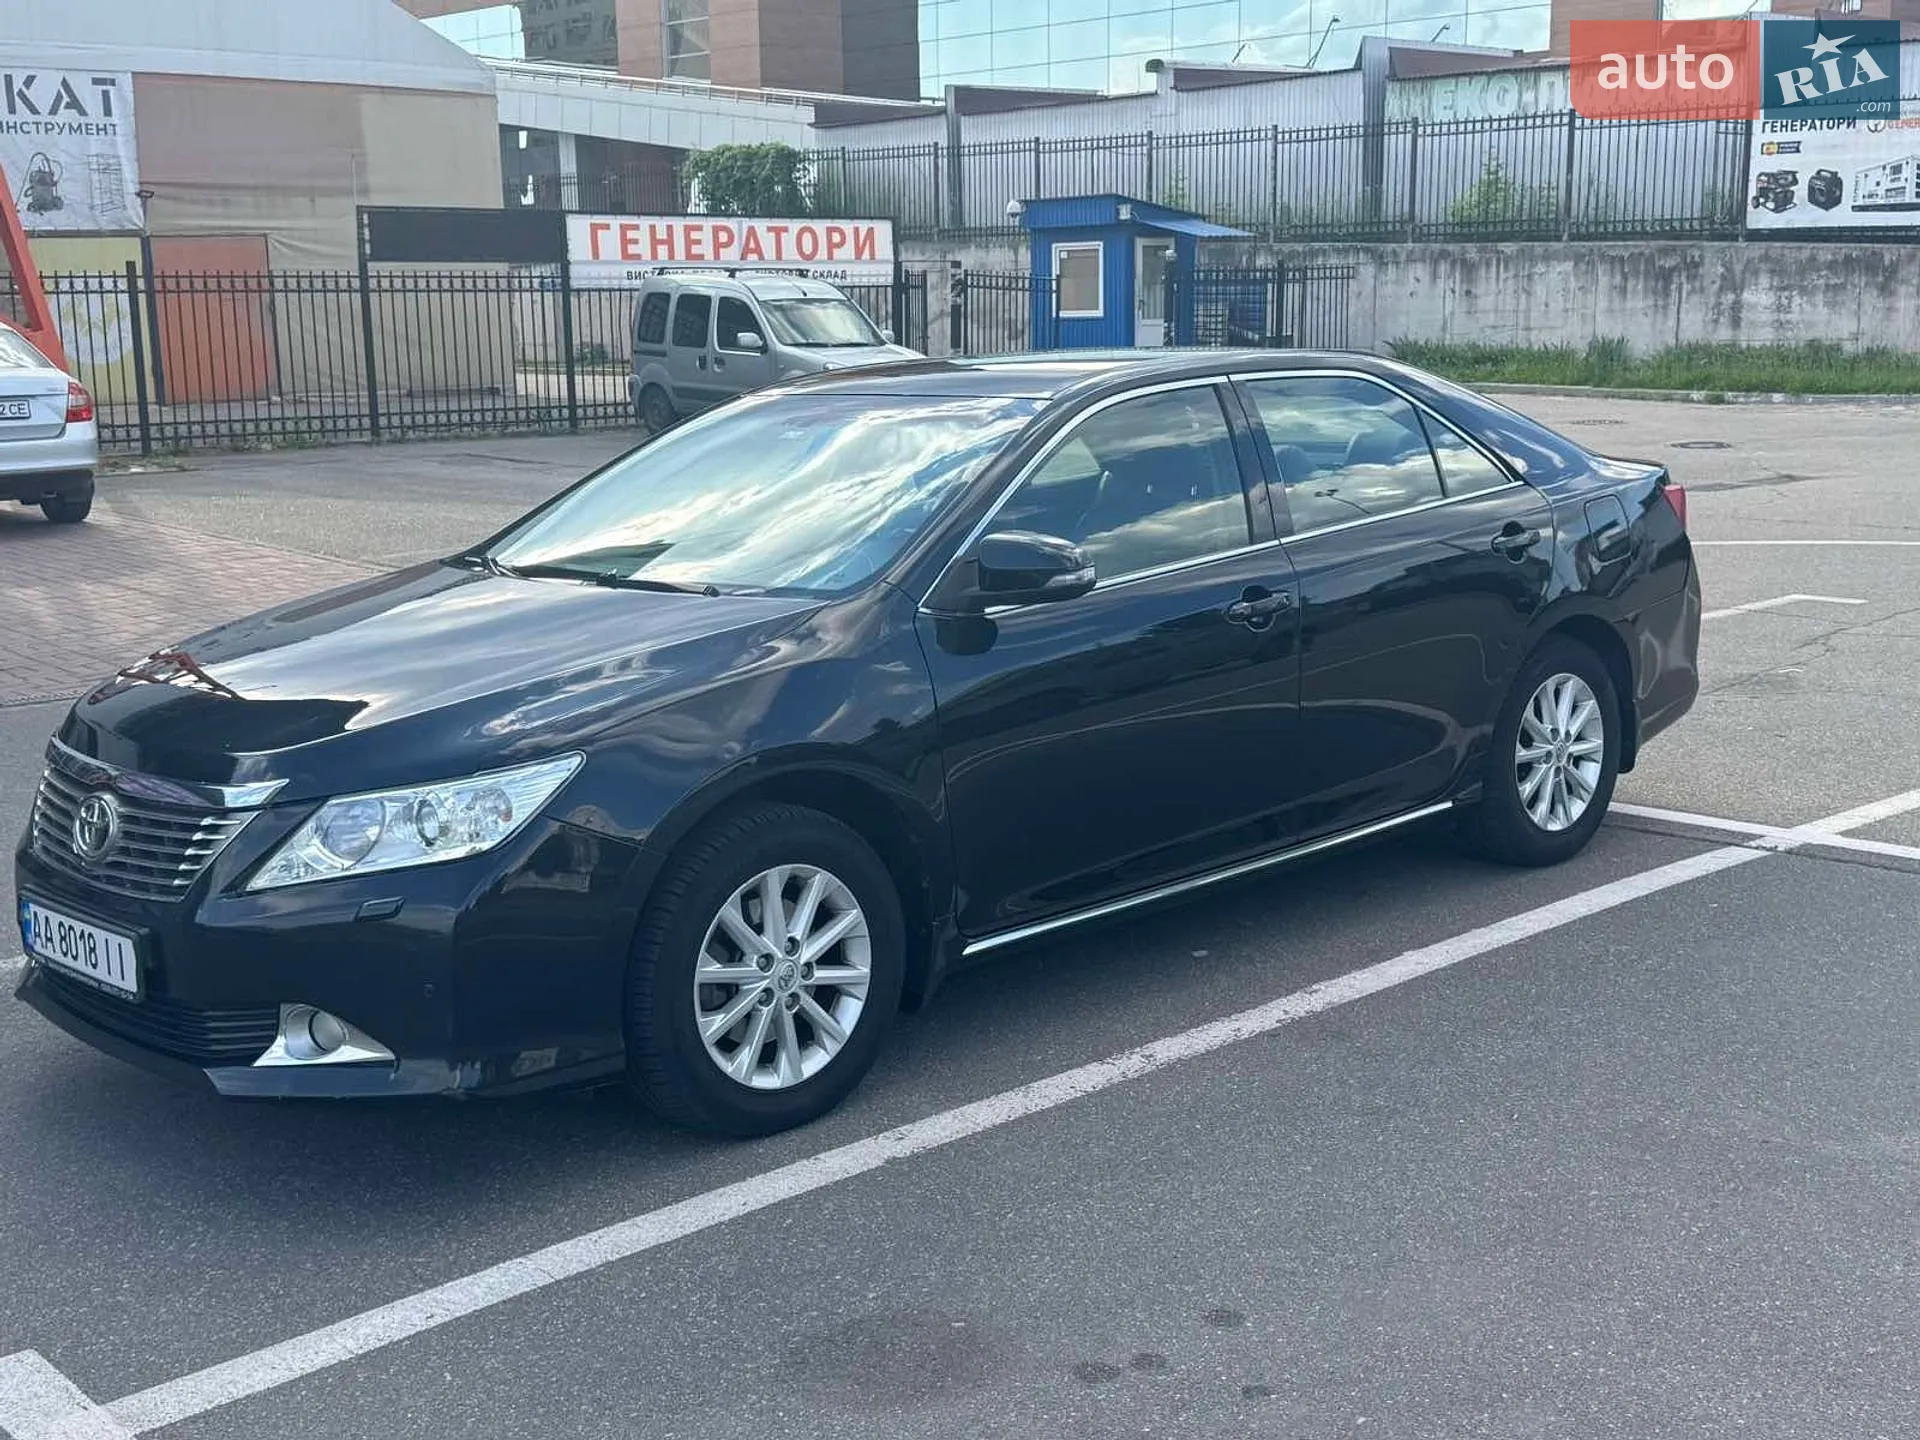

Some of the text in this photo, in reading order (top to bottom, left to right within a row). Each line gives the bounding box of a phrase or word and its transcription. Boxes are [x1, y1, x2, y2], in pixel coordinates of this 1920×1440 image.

[4, 74, 117, 117] КАТ
[1762, 116, 1857, 134] ГЕНЕРАТОРИ
[589, 222, 876, 261] ГЕНЕРАТОРИ
[812, 269, 848, 281] СКЛАД
[33, 910, 56, 954] AA
[58, 920, 98, 970] 8018
